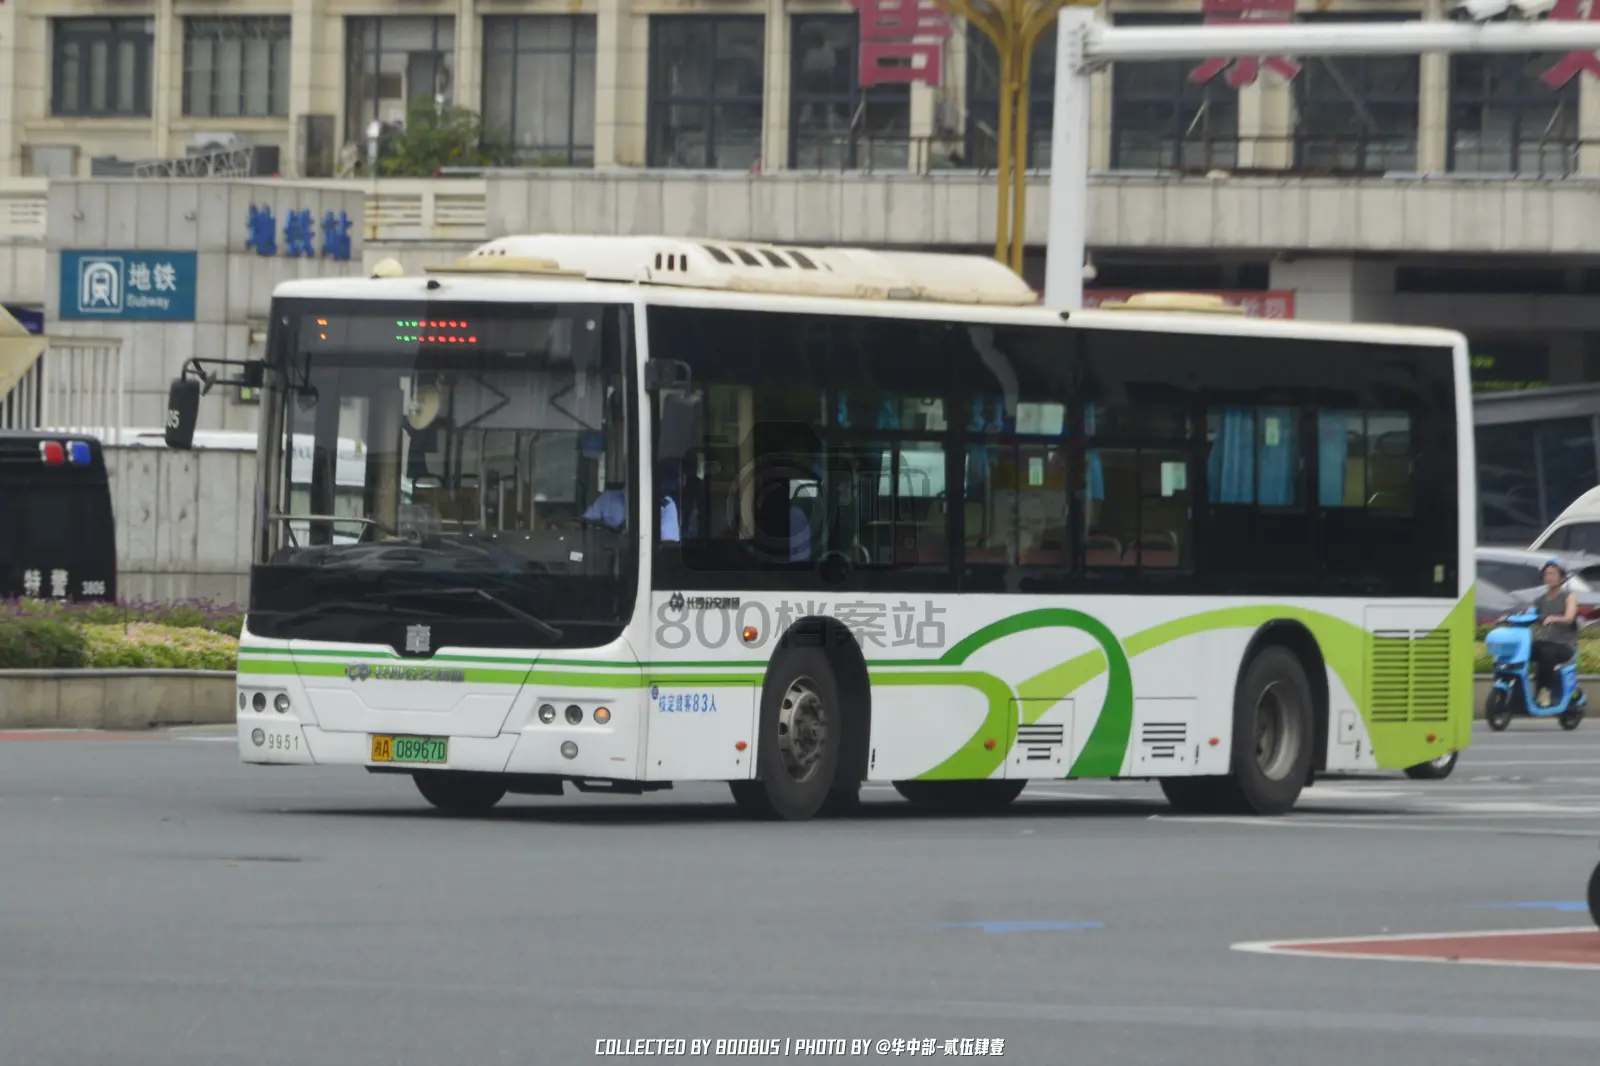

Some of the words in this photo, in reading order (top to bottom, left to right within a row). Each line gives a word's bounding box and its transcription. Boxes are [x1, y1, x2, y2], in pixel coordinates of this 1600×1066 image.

[246, 203, 351, 260] 地铁站
[128, 262, 177, 292] 地铁
[126, 295, 170, 310] Subway
[268, 734, 299, 750] 9951
[396, 740, 446, 759] 08967D
